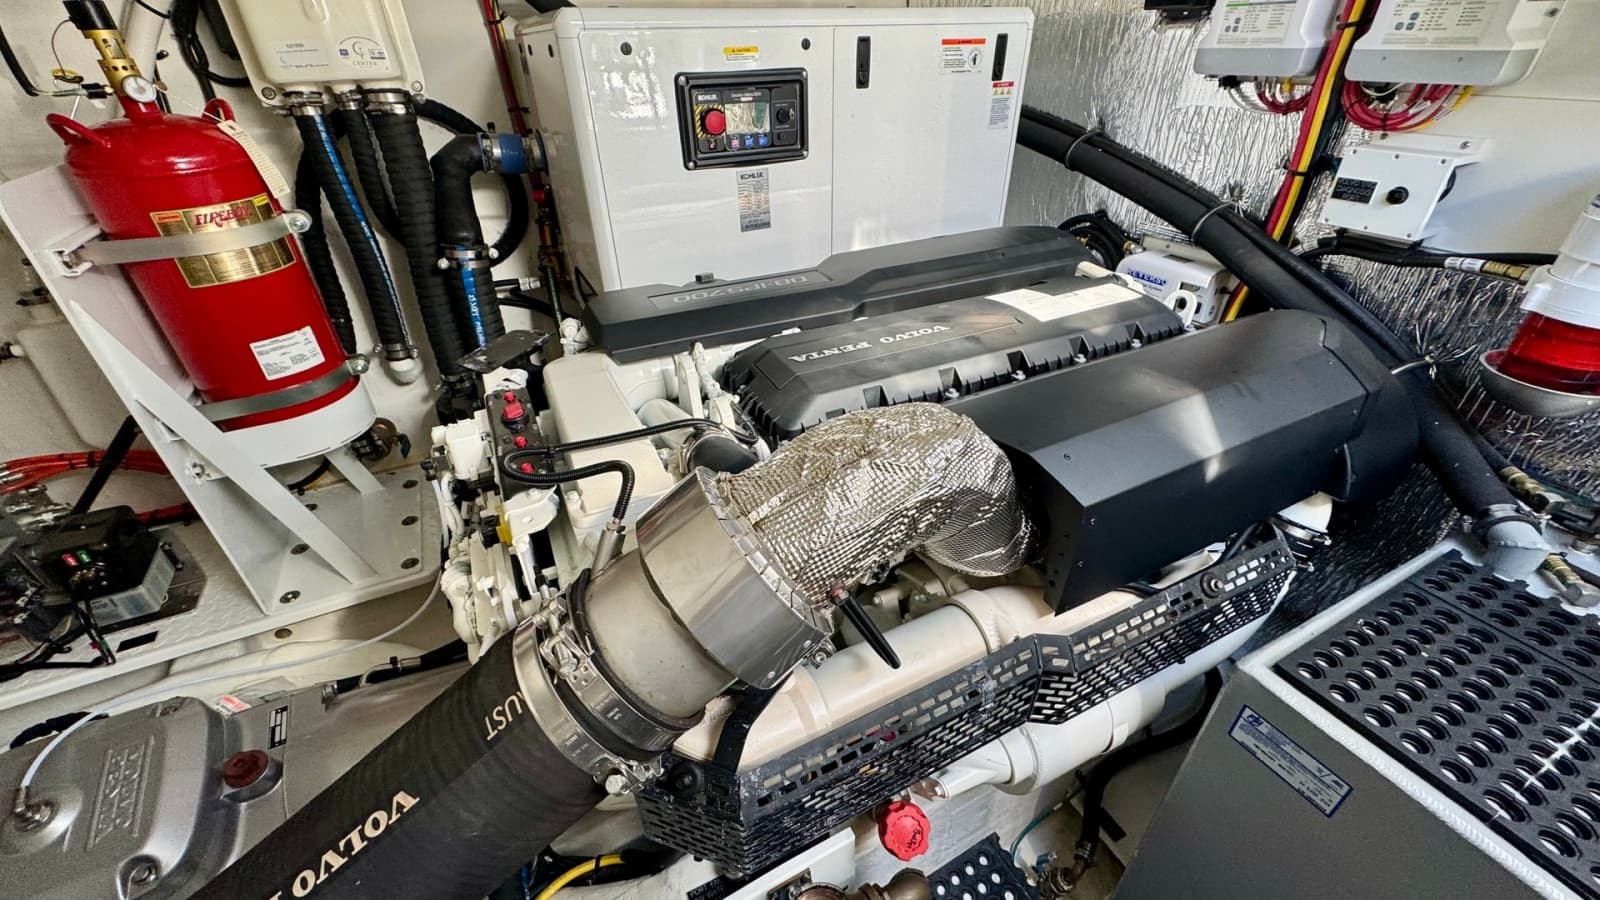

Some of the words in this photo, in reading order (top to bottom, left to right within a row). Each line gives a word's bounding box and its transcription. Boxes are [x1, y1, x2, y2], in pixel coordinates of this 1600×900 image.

[787, 341, 873, 363] PENTA
[879, 325, 951, 344] VOLVO
[485, 691, 524, 740] UST
[292, 790, 421, 898] VOLVO
